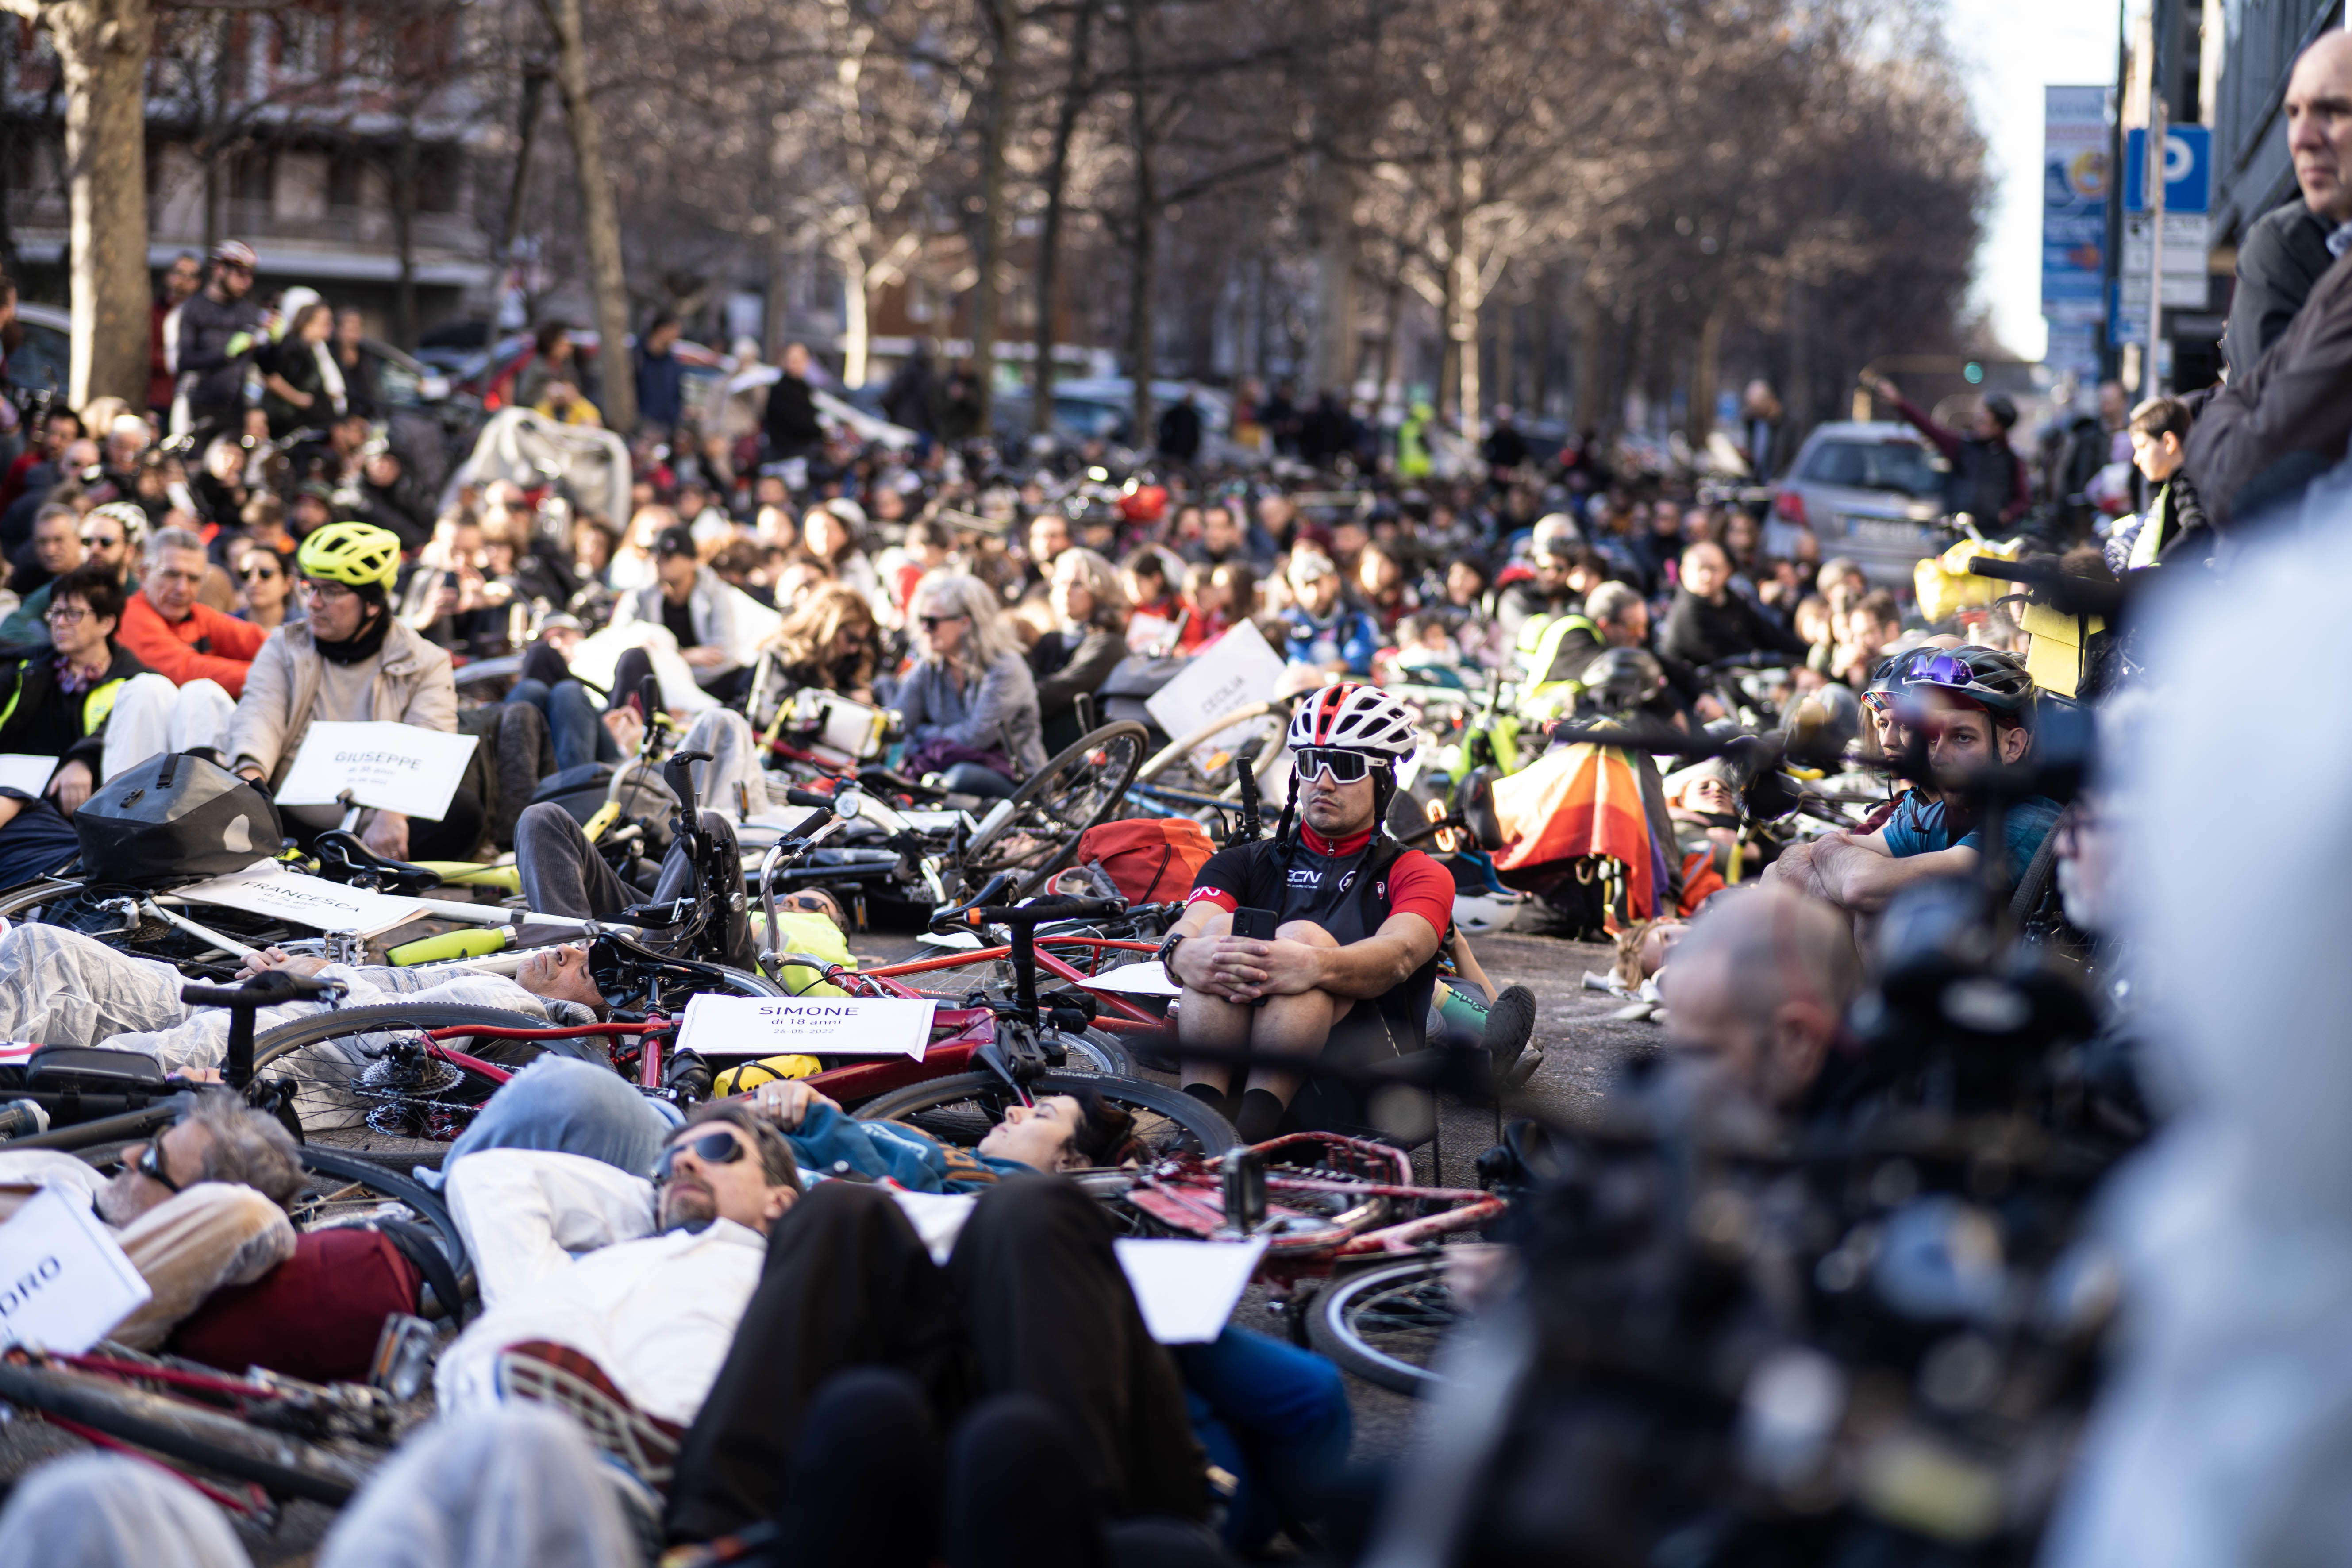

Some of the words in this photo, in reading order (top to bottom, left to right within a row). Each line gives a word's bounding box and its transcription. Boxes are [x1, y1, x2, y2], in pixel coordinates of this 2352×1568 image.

[335, 751, 423, 770] GIUSEPPE
[241, 881, 359, 912] FRANCESCA
[758, 1007, 859, 1016] SIMONE
[1050, 1070, 1100, 1079] Cinturato
